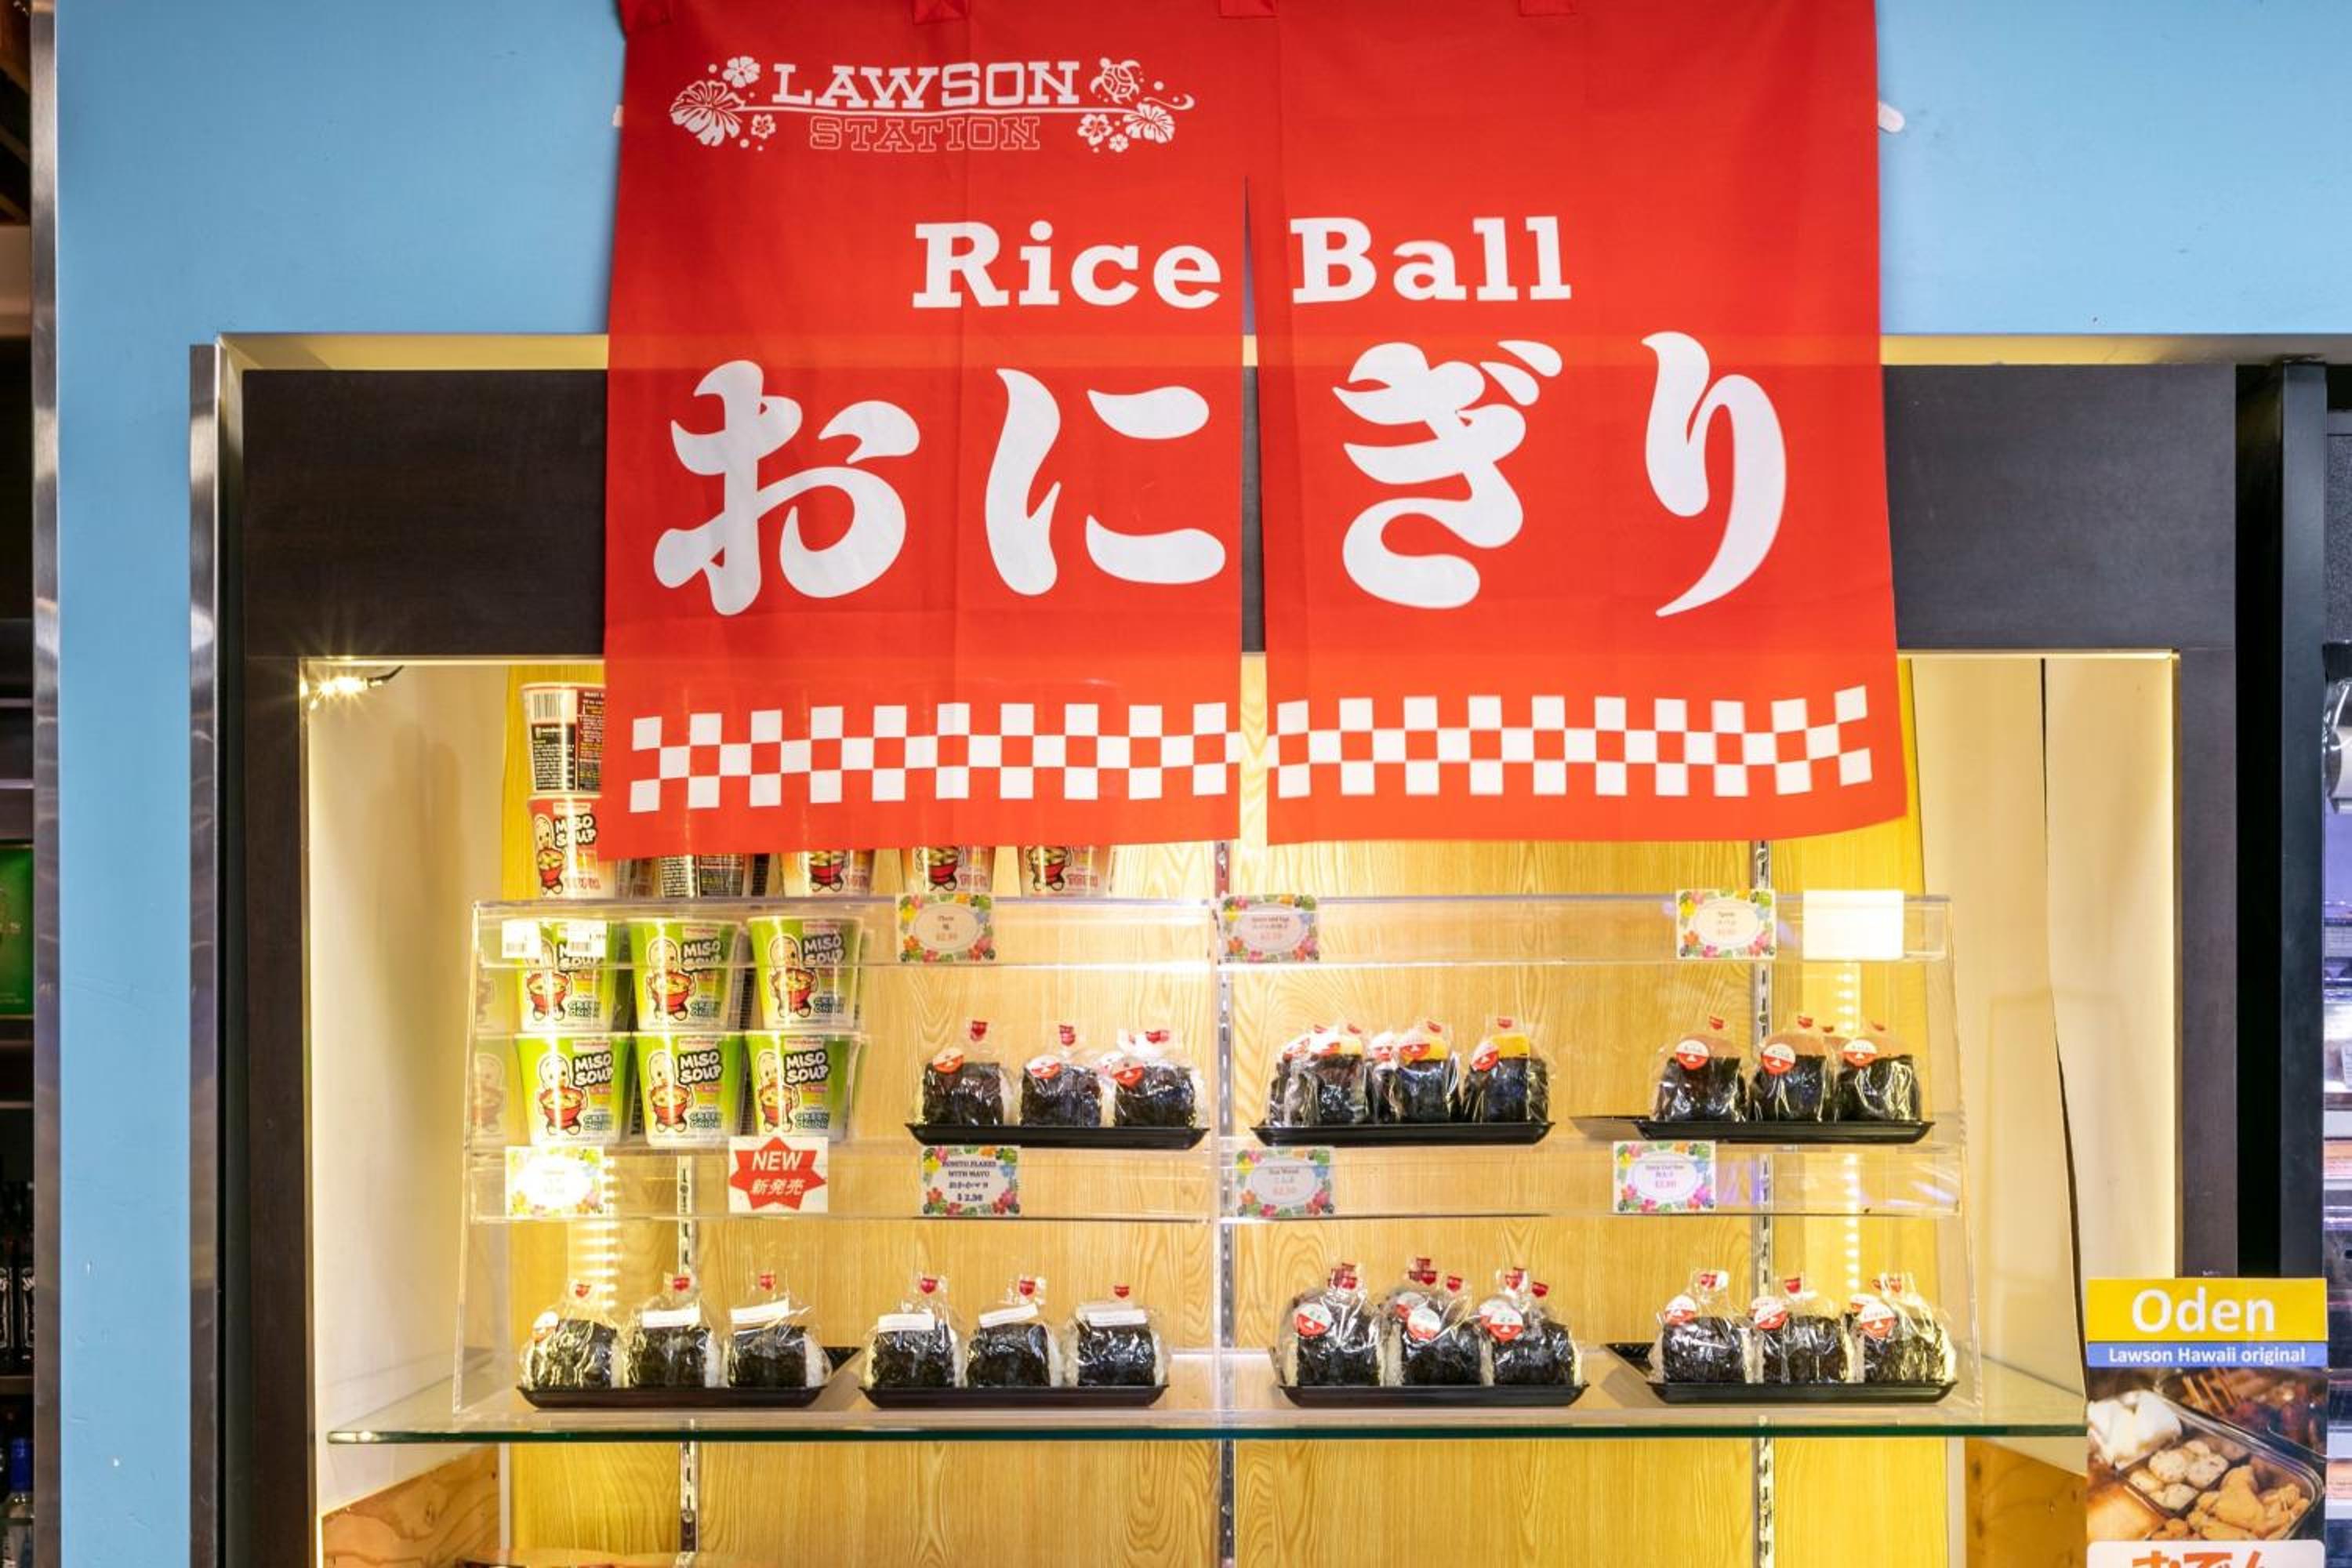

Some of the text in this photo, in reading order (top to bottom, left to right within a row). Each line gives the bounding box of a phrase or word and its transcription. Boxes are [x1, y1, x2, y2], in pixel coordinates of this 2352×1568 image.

[771, 60, 1080, 110] LAWSON
[809, 115, 1040, 152] STATION
[913, 216, 1571, 309] Rice Ball
[654, 332, 1787, 617] おにぎり
[556, 829, 596, 847] SUP
[682, 941, 721, 957] MISO
[804, 934, 842, 953] MISO
[804, 948, 844, 966] SOUP
[575, 1053, 612, 1072] MISO
[679, 1051, 720, 1069] MISO
[786, 1051, 826, 1069] MISO
[575, 1067, 613, 1087] SOUP
[680, 1065, 722, 1083] SOUP
[786, 1065, 829, 1083] SOUP
[752, 1150, 803, 1171] NEW
[752, 1178, 806, 1196] 新発売
[2132, 1287, 2275, 1333] Oden
[2108, 1347, 2306, 1365] Lawson Hawaii original
